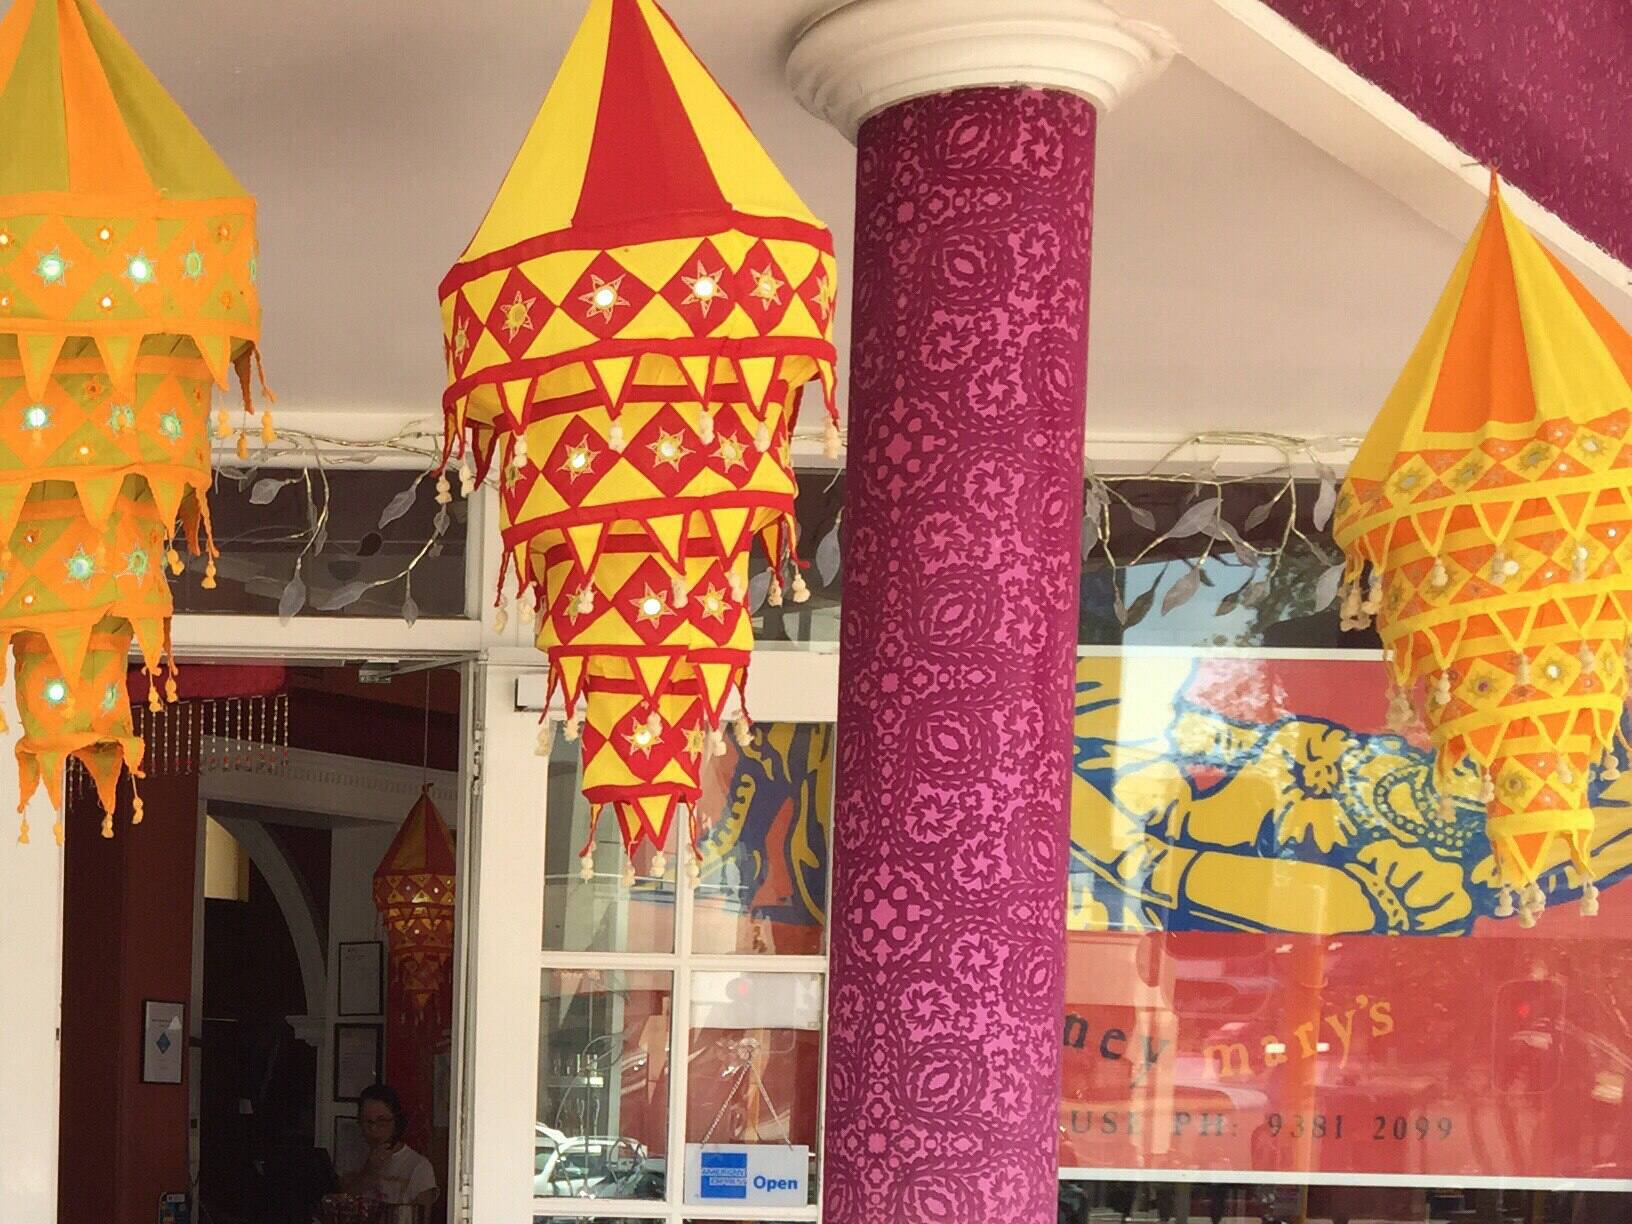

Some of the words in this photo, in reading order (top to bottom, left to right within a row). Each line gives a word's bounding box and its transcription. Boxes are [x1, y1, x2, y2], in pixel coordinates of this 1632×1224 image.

[1202, 994, 1394, 1078] mary's
[1269, 1114, 1344, 1138] 9381
[1373, 1115, 1453, 1140] 2099
[753, 1175, 798, 1192] Open
